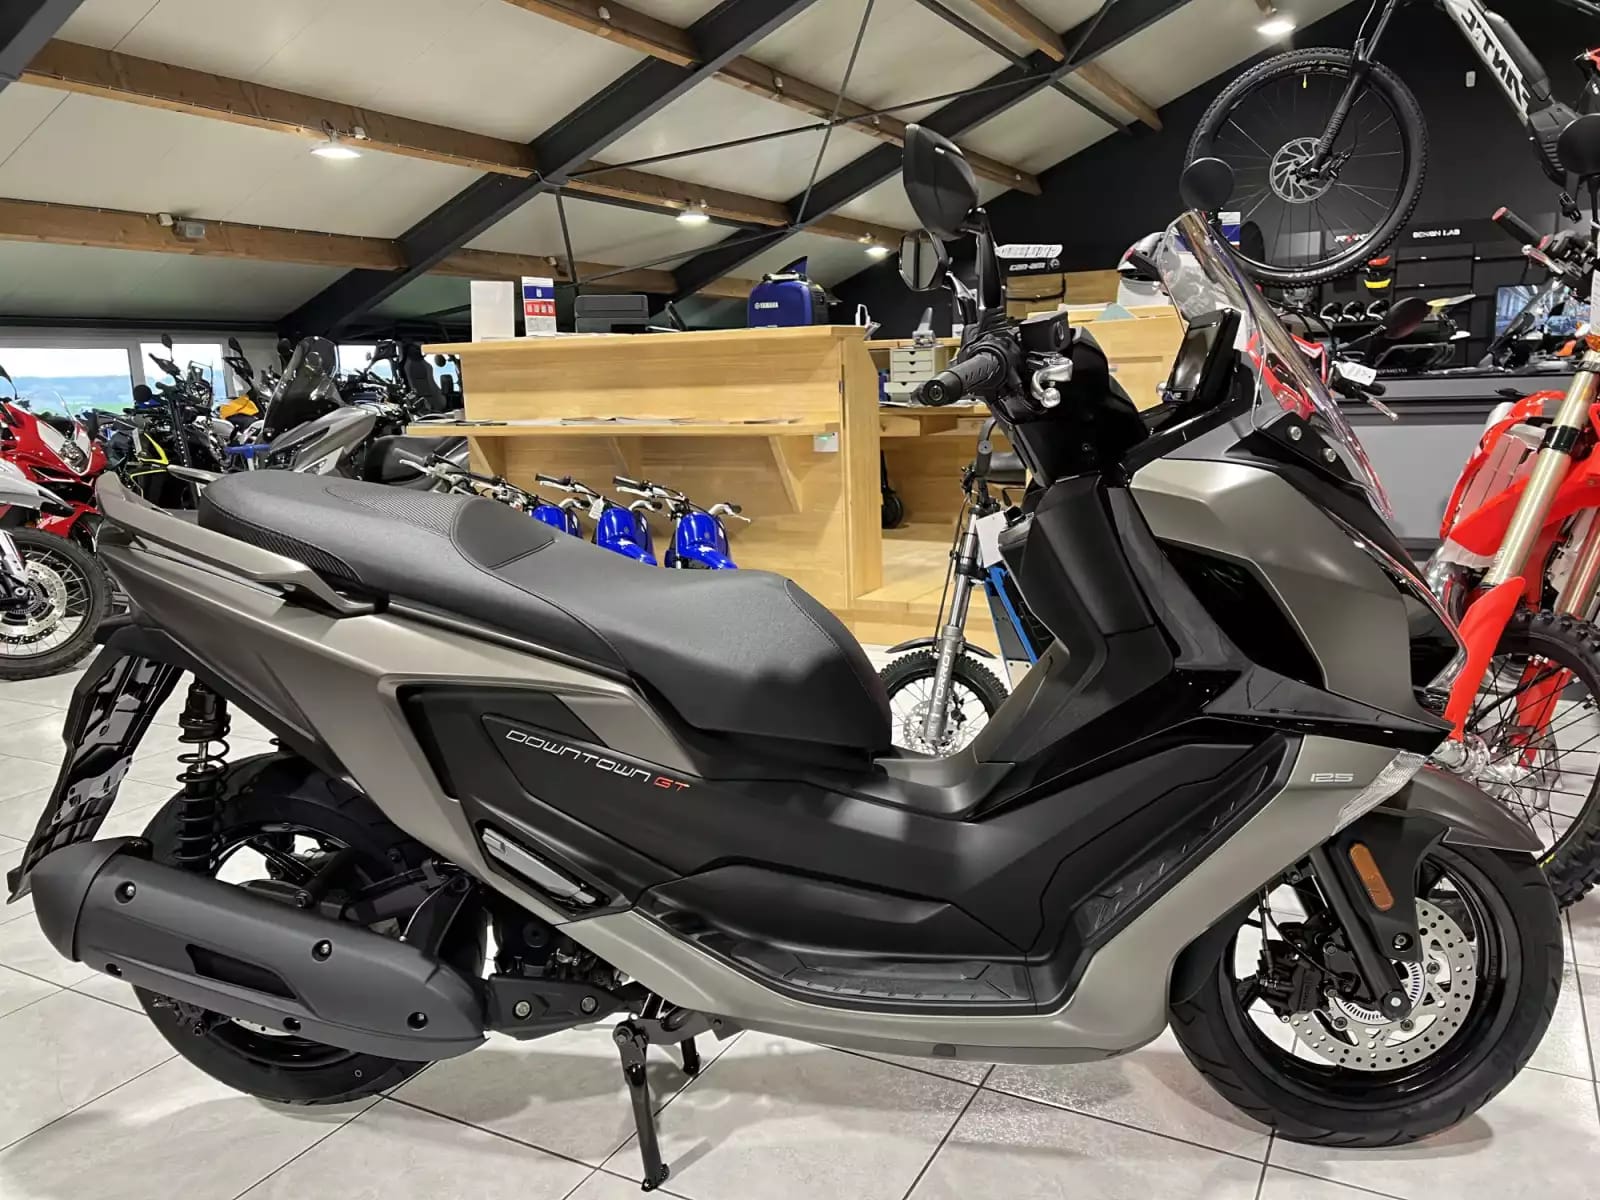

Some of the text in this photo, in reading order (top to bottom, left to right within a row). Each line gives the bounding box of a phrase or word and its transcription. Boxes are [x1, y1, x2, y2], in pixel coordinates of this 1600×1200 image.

[933, 645, 952, 706] TORROT
[505, 729, 690, 792] DOWNTOWN GT
[1310, 773, 1354, 783] 125
